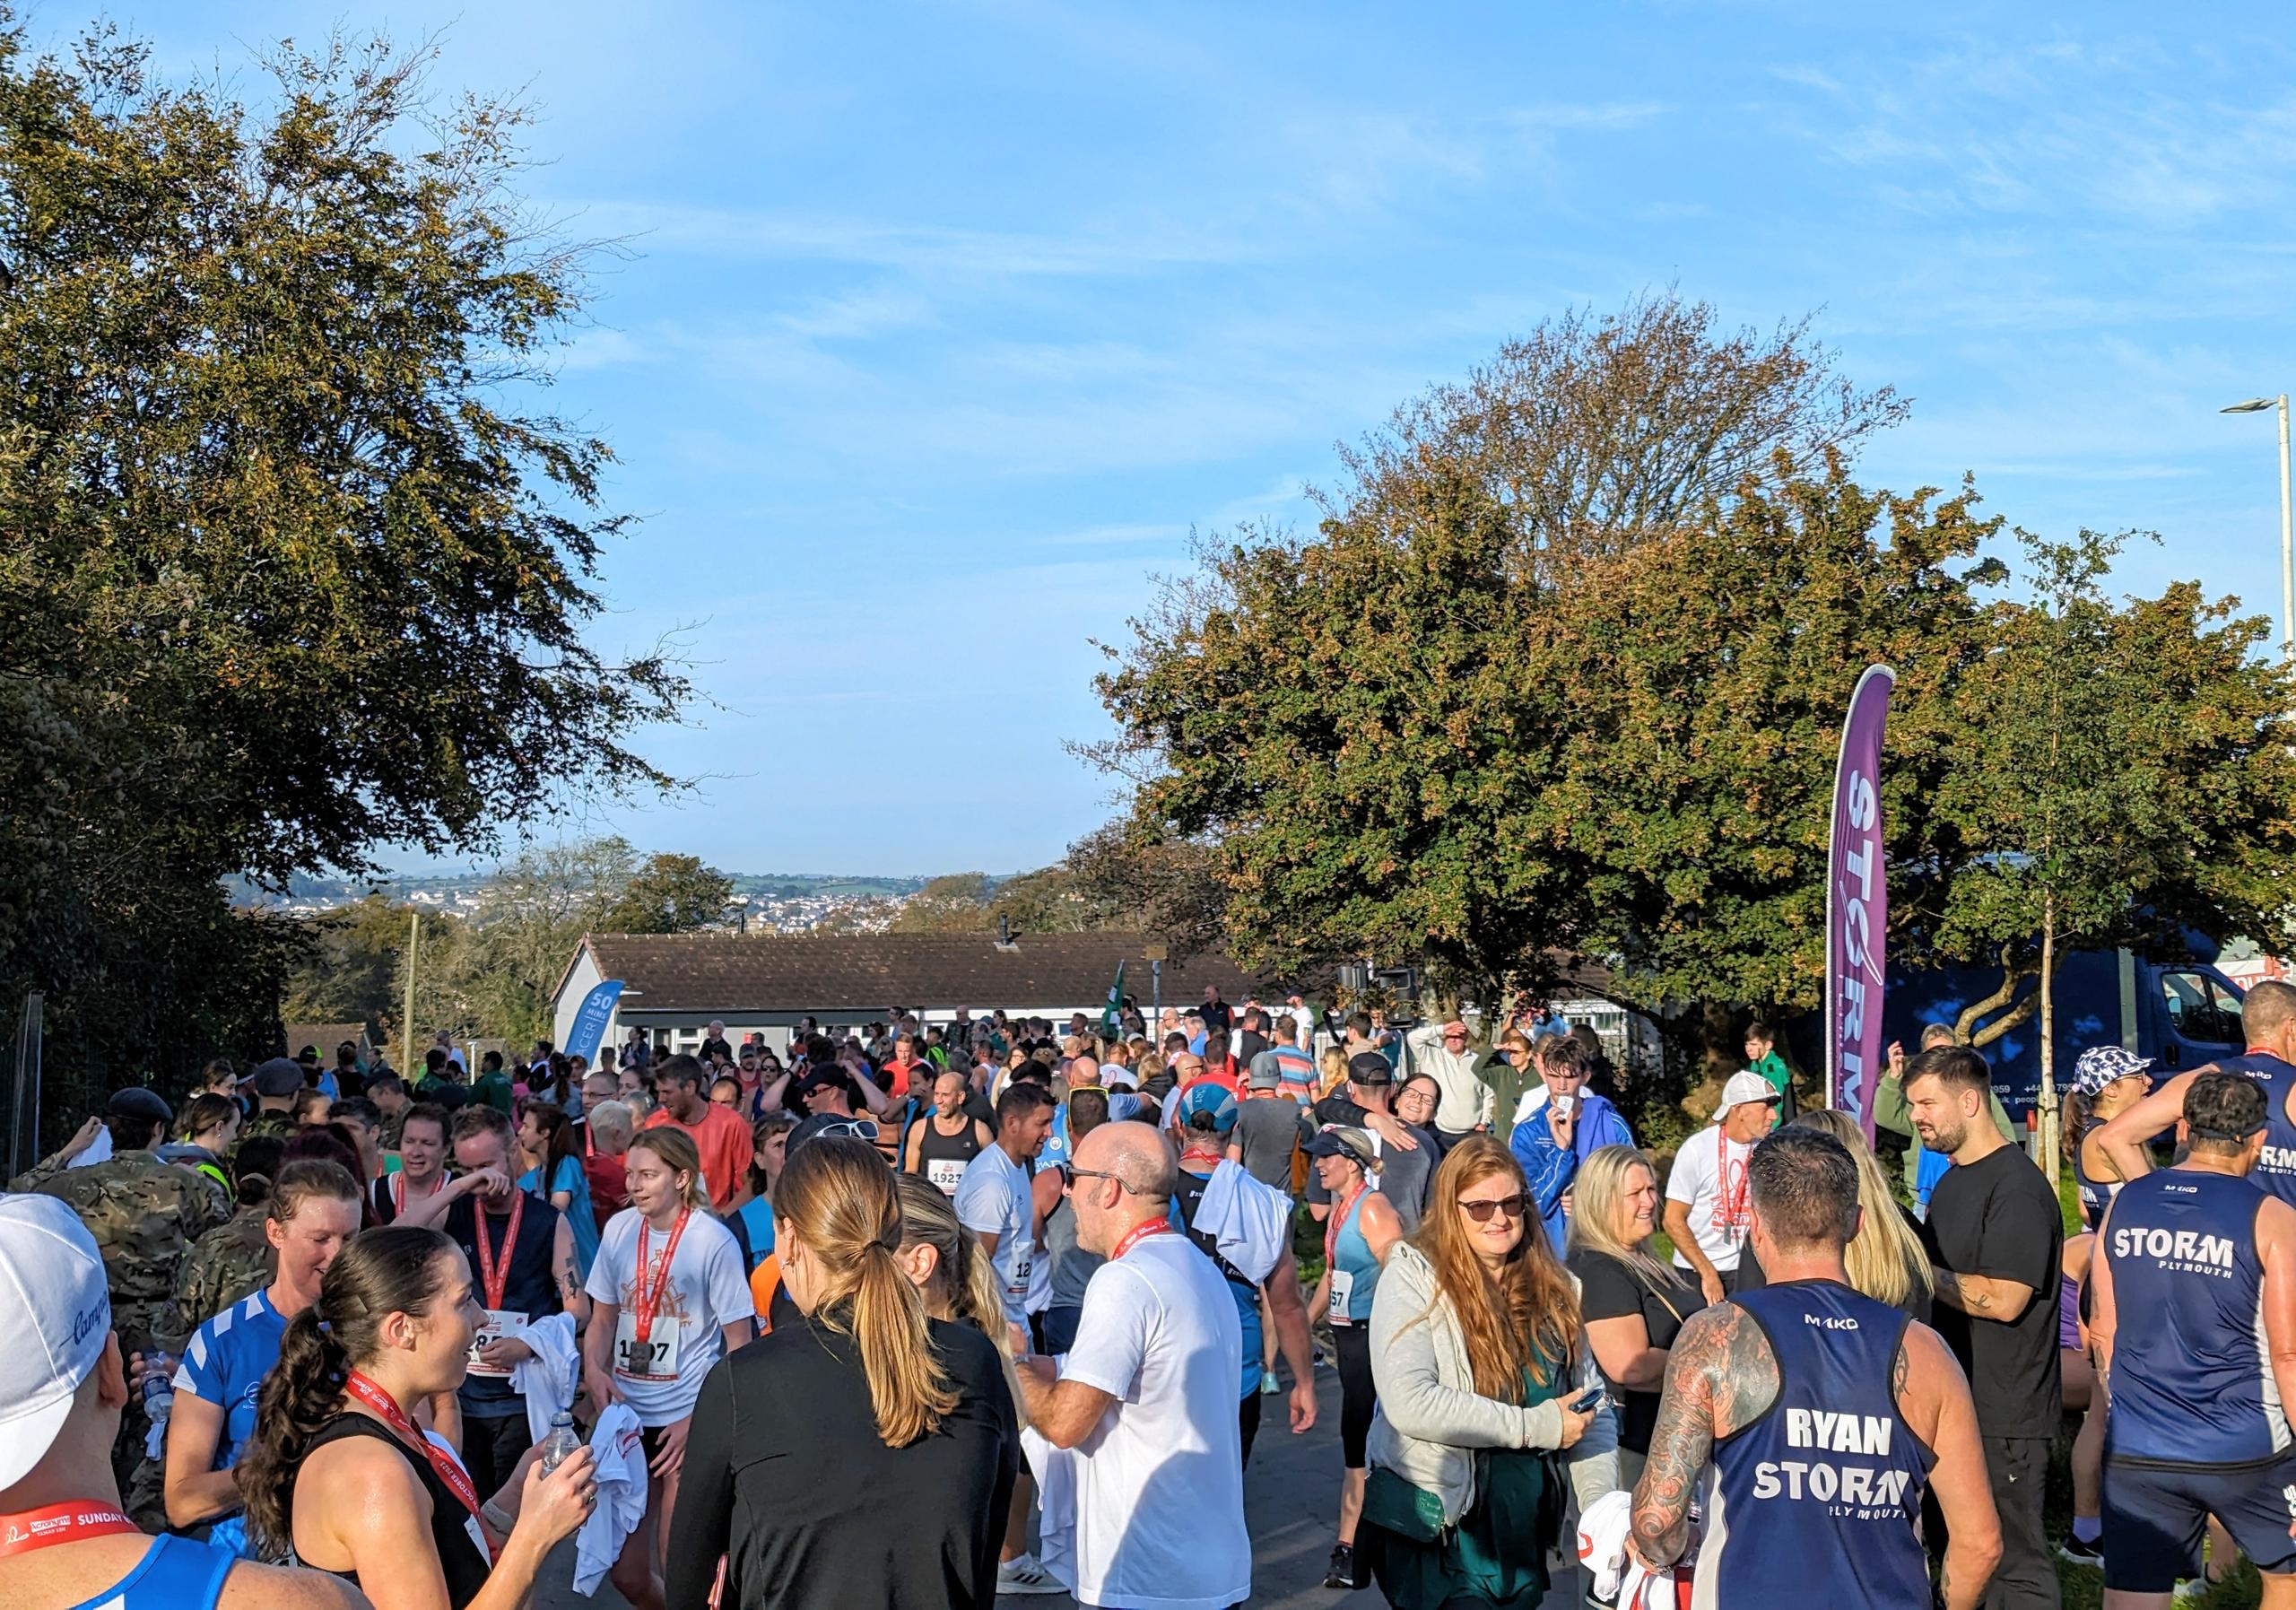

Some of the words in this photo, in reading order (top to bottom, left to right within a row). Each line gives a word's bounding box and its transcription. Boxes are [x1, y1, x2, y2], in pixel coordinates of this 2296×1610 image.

[1844, 769, 1875, 1128] STORM
[591, 992, 613, 1010] 50
[587, 1008, 606, 1019] MINS
[575, 1023, 596, 1057] ACER
[2114, 1228, 2234, 1268] STORM
[1016, 1262, 1032, 1277] 12
[2159, 1260, 2233, 1279] PLYMOUTH
[1805, 1313, 1859, 1330] MAKO
[1787, 1408, 1892, 1456] RYAN
[1752, 1461, 1910, 1506] STORM
[77, 1512, 123, 1526] SUNDAY
